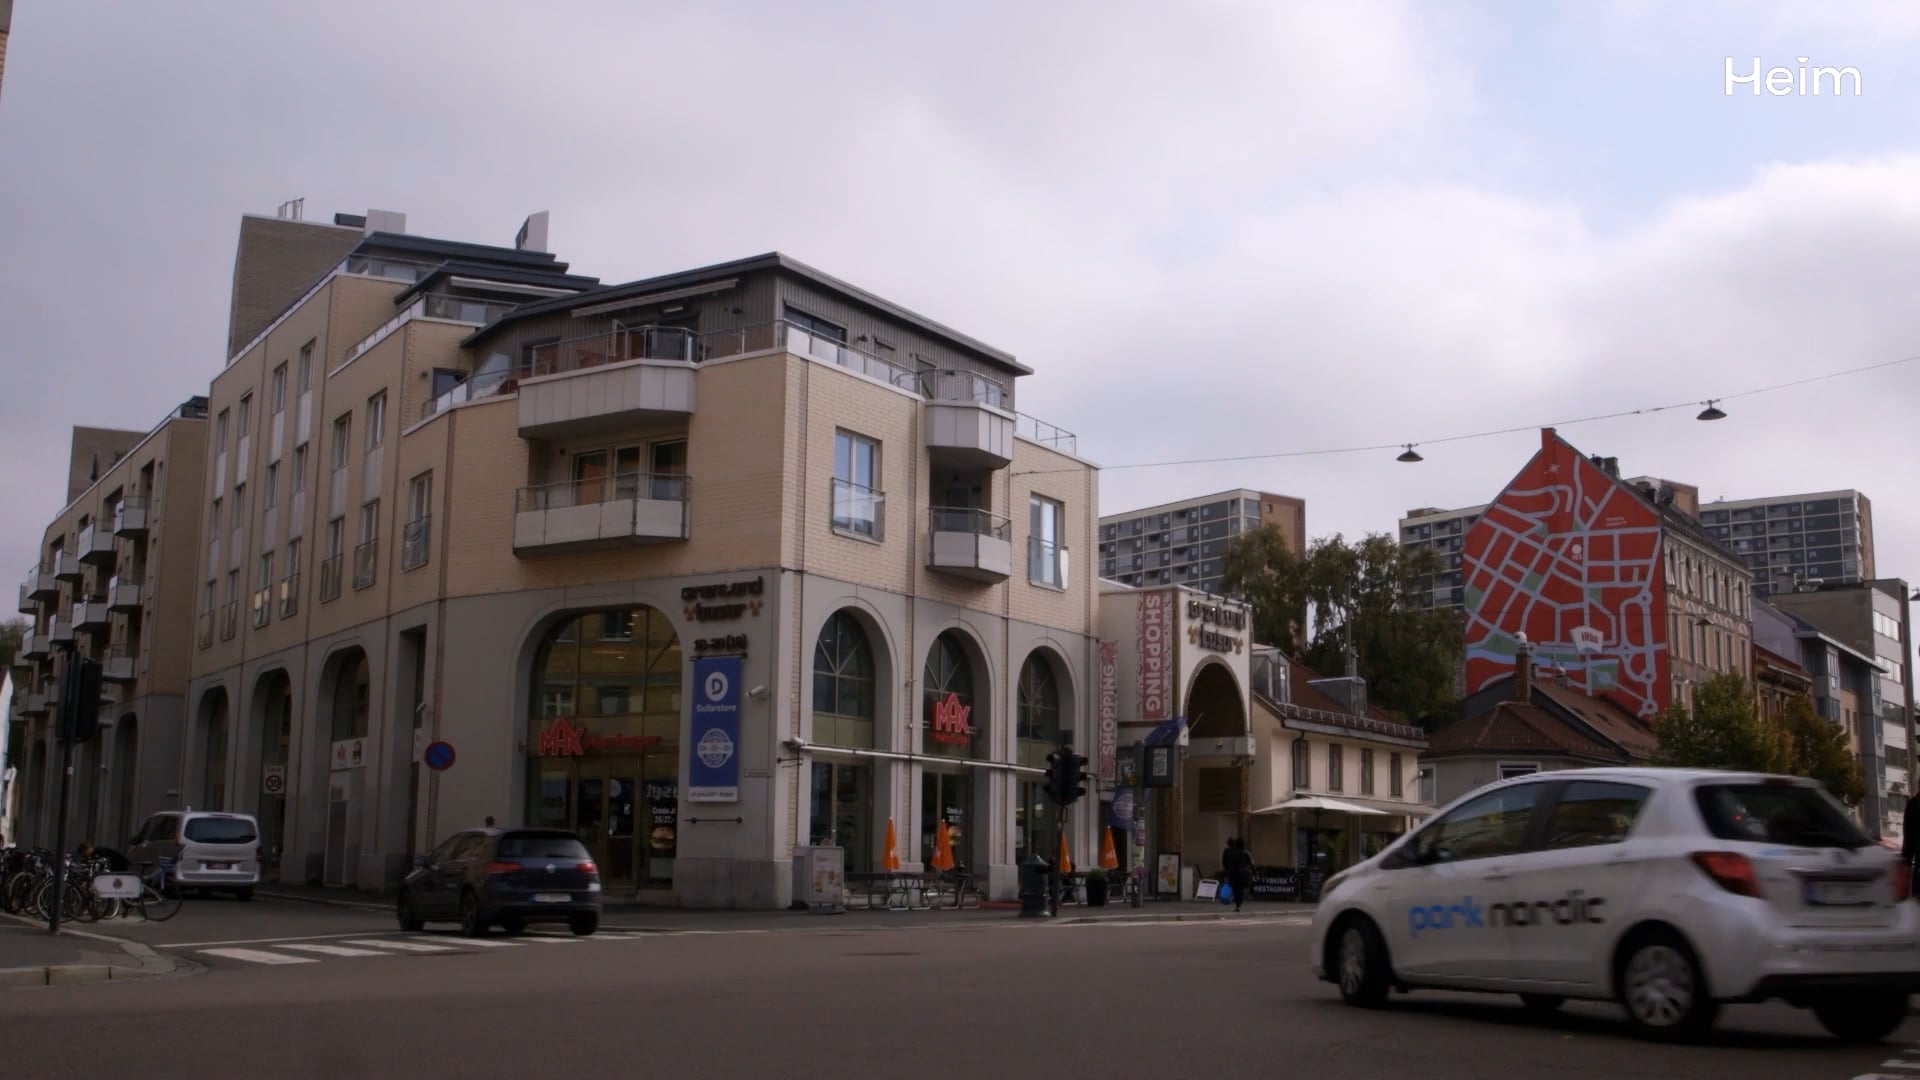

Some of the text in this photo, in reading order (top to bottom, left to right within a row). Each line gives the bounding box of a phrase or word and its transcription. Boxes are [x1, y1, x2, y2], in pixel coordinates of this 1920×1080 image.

[1145, 595, 1162, 712] SHOPPING
[712, 679, 723, 695] D
[696, 704, 737, 713] Dollarstore
[936, 692, 971, 735] MAX
[1102, 665, 1114, 755] SHOPPING
[538, 715, 585, 757] MAX
[1254, 885, 1295, 893] RESTAURANT
[1408, 890, 1607, 938] park nordic
